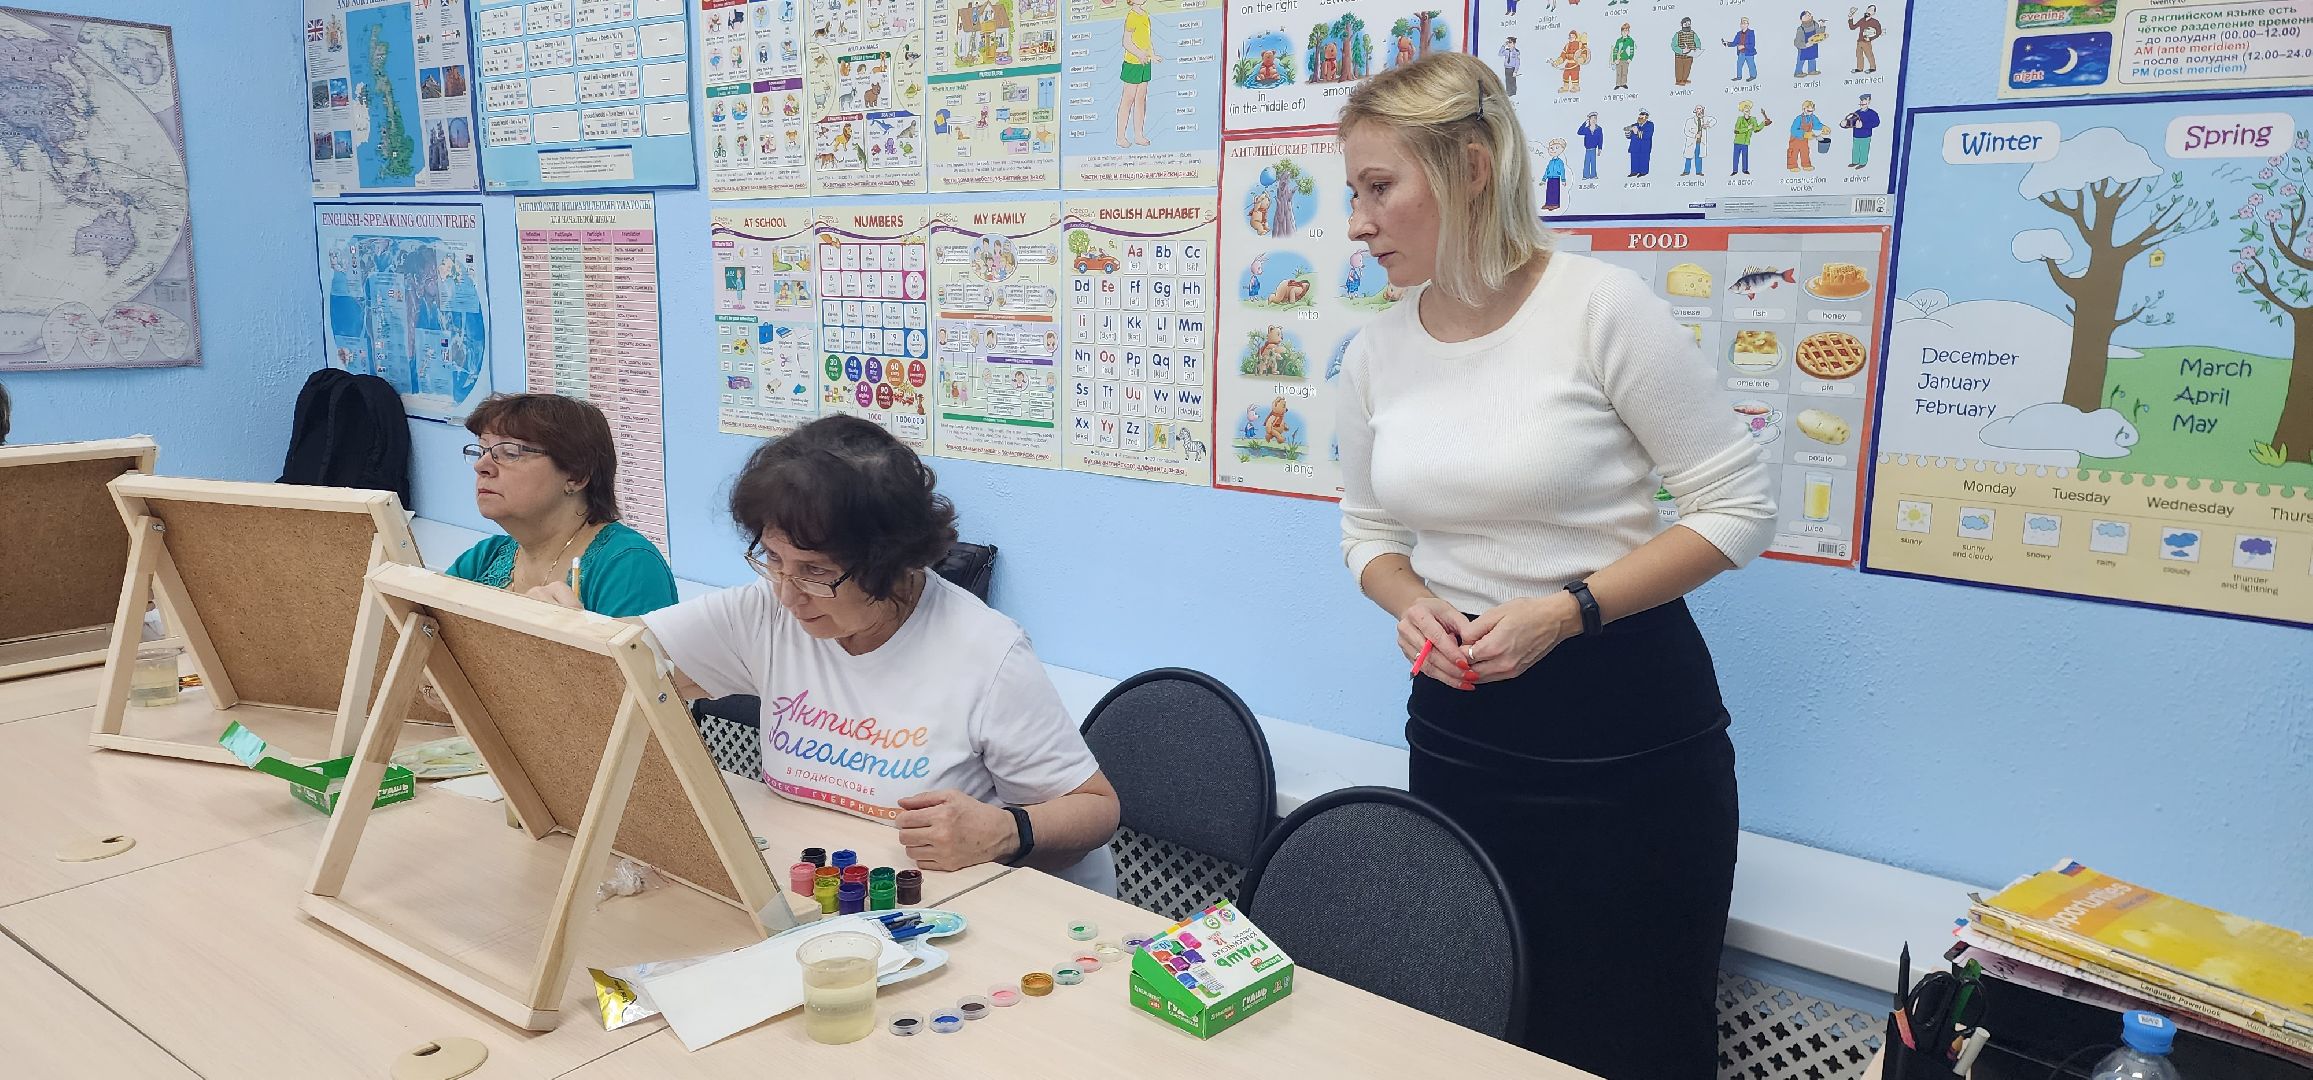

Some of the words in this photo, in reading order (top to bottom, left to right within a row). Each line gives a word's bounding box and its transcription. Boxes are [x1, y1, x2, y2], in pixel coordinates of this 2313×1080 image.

[1242, 6, 1253, 14] on
[1257, 2, 1272, 12] the
[1275, 0, 1297, 12] right
[2019, 10, 2066, 21] evening
[2139, 15, 2147, 23] В
[2151, 11, 2222, 22] английском
[2226, 8, 2265, 18] языке
[2268, 6, 2297, 15] есть
[2138, 25, 2177, 34] чёткое
[2181, 20, 2254, 33] разделение
[2146, 36, 2161, 45] до
[2165, 33, 2216, 45] полудня
[2135, 46, 2153, 55] AM
[2157, 45, 2187, 57] (ante
[2189, 41, 2250, 53] meridiem)
[2143, 57, 2179, 66] после
[2186, 53, 2238, 65] полудня
[2013, 70, 2045, 82] night
[2132, 67, 2150, 77] PM
[2153, 66, 2183, 78] (post
[2187, 64, 2247, 76] meridiem)
[1258, 92, 1266, 101] in
[1229, 104, 1240, 116] (in
[1243, 102, 1257, 113] the
[1291, 98, 1306, 110] of)
[1961, 131, 2043, 157] Winter
[2184, 124, 2273, 151] Spring
[1231, 143, 1307, 157] АНГЛИЙСКИЕ
[1849, 175, 1870, 183] driver
[322, 212, 414, 228] ENGLISH-SPEAKING
[416, 213, 476, 228] COUNTRIES
[974, 213, 988, 224] MY
[991, 212, 1026, 224] FAMILY
[1100, 208, 1143, 220] ENGLISH
[1145, 207, 1201, 220] ALPHABET
[744, 218, 753, 228] AT
[755, 217, 787, 228] SCHOOL
[854, 215, 904, 227] NUMBERS
[1309, 228, 1324, 240] up
[1627, 233, 1689, 249] FOOD
[1127, 245, 1143, 258] Aa
[1155, 245, 1171, 258] Bb
[1185, 246, 1200, 258] Cc
[1074, 280, 1090, 292] Dd
[1101, 280, 1115, 292] Ee
[1130, 281, 1141, 293] Ff
[1154, 281, 1171, 297] Gg
[1182, 282, 1200, 294] Hh
[1298, 309, 1320, 320] into
[1751, 309, 1768, 318] fish
[1822, 312, 1847, 322] honey
[1103, 316, 1112, 331] Jj
[1127, 316, 1142, 329] Kk
[1179, 319, 1203, 331] Mm
[1075, 349, 1090, 361] Nn
[1100, 350, 1116, 363] Oo
[1127, 352, 1141, 368] Pp
[1183, 355, 1197, 368] Rr
[1921, 348, 2019, 366] December
[1152, 354, 1170, 370] Qq
[2180, 358, 2252, 378] March
[1821, 383, 1834, 392] pie
[1918, 373, 1991, 392] January
[1076, 383, 1089, 396] Ss
[1103, 385, 1113, 397] Tt
[1125, 387, 1141, 400] Uu
[1153, 389, 1169, 402] Vv
[1274, 384, 1317, 398] through
[2174, 386, 2230, 406] April
[1178, 390, 1202, 404] Ww
[1915, 399, 1996, 419] February
[1075, 417, 1089, 429] Xx
[1101, 419, 1114, 434] Yy
[1126, 422, 1140, 435] Zz
[2173, 415, 2218, 434] May
[1284, 463, 1314, 477] along
[1963, 480, 2016, 497] Monday
[2052, 487, 2110, 505] Tuesday
[2147, 496, 2234, 518] Wednesday
[1900, 537, 1922, 546] sunny
[1962, 544, 1985, 553] sunny
[2026, 551, 2051, 560] snowy
[2233, 574, 2268, 584] thunder
[2240, 583, 2278, 596] lightning
[773, 689, 928, 749] Активное
[795, 769, 875, 796] ПОДМОСКОВЬЕ
[2047, 882, 2132, 930] pportunities
[1215, 938, 1269, 969] ГУАШЬ
[2140, 982, 2176, 1001] Language
[2178, 996, 2222, 1018] Powerbook
